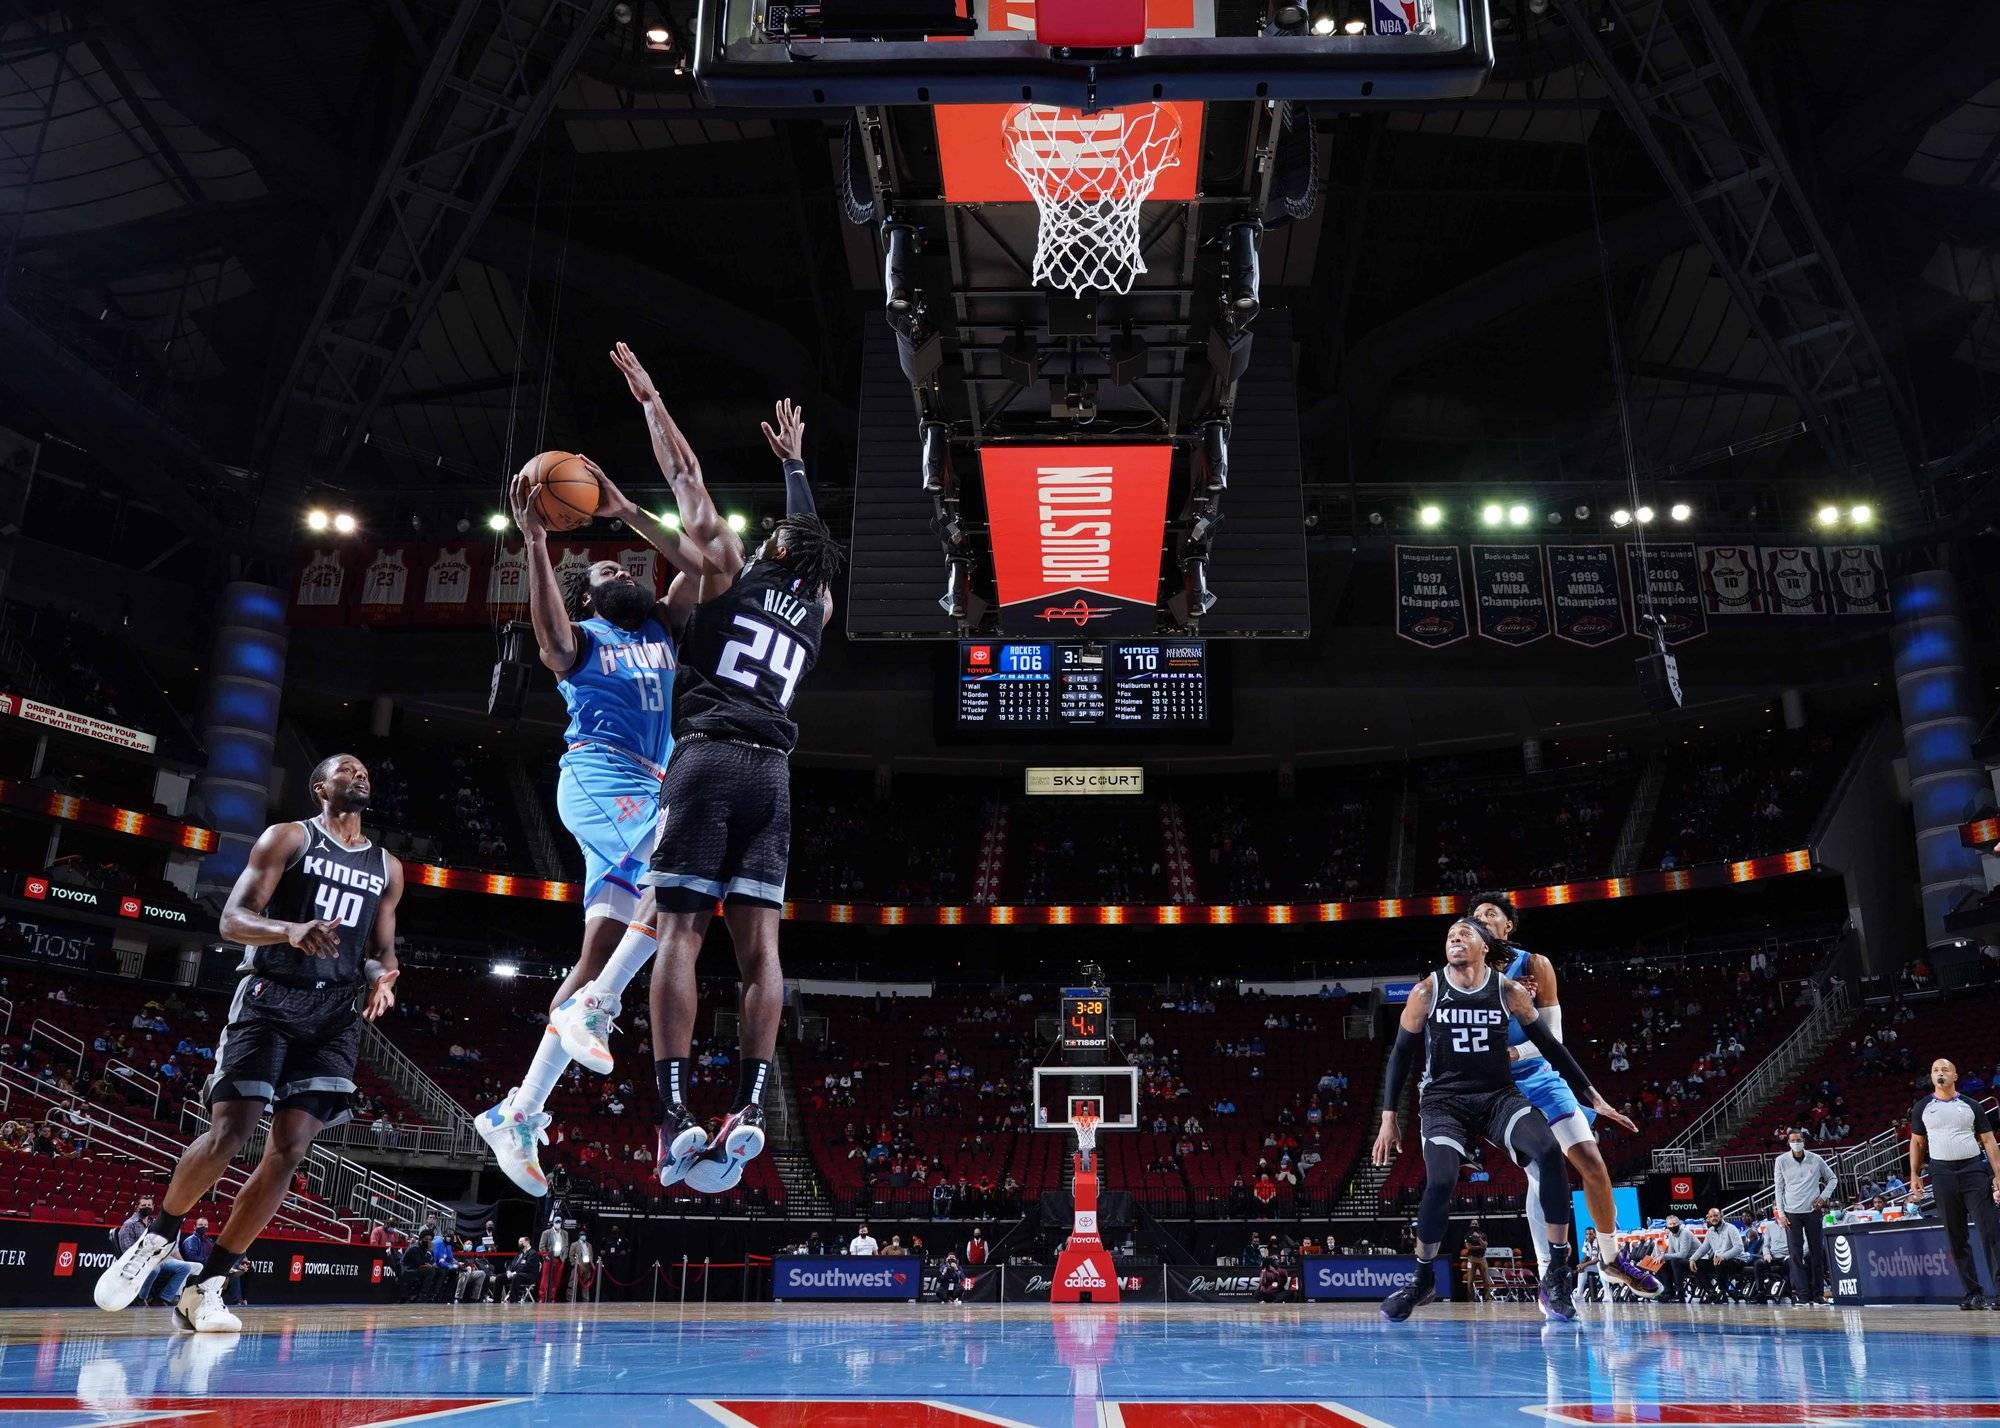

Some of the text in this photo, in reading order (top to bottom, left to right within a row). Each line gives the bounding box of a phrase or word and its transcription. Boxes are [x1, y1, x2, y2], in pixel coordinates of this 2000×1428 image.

[1379, 20, 1402, 33] NBA
[1036, 466, 1113, 583] HOUSTON
[377, 572, 395, 586] 23
[439, 570, 459, 585] 24
[501, 571, 520, 586] 22
[1416, 572, 1442, 584] 1997
[1495, 571, 1525, 583] 1998
[1571, 571, 1600, 582] 1999
[1649, 570, 1679, 580] 2000
[1413, 584, 1448, 595] WNBA
[1491, 584, 1530, 595] WNBA
[1567, 583, 1604, 595] WNBA
[1650, 581, 1685, 592] WNBA
[764, 588, 808, 627] HIELD
[1401, 595, 1461, 609] Champions
[1481, 596, 1543, 608] Champions
[1557, 595, 1618, 608] Champions
[1010, 646, 1041, 655] ROCKETS
[715, 614, 806, 707] 24
[1009, 655, 1042, 671] 106
[1124, 654, 1157, 670] 110
[633, 675, 664, 712] 13
[26, 702, 137, 739] ORDER A BEER FROM YOUR
[24, 711, 150, 751] SEAT WITH THE ROCKETS APP!
[1053, 775, 1084, 786] SKY
[1088, 775, 1140, 787] COURT
[303, 855, 385, 897] KINGS
[51, 887, 98, 905] TOYOTA
[315, 883, 364, 928] 40
[144, 905, 187, 923] TOYOTA
[17, 921, 96, 961] Frost
[1077, 1001, 1103, 1015] 3:28
[1436, 1009, 1502, 1024] KINGS
[1072, 1016, 1094, 1036] 4.4
[1077, 1039, 1106, 1047] TISSOT
[1451, 1027, 1490, 1053] 22
[1670, 1203, 1698, 1211] TOYOTA
[0, 1250, 27, 1266] TER
[1868, 1246, 1949, 1279] Southwest
[250, 1260, 274, 1274] NTER
[305, 1262, 359, 1276] TOYOTA CENTER
[789, 1268, 892, 1287] Southwest
[1065, 1277, 1107, 1288] adidas
[1215, 1277, 1260, 1291] MISS
[1319, 1267, 1416, 1287] Southwes
[1838, 1279, 1858, 1296] AT&T
